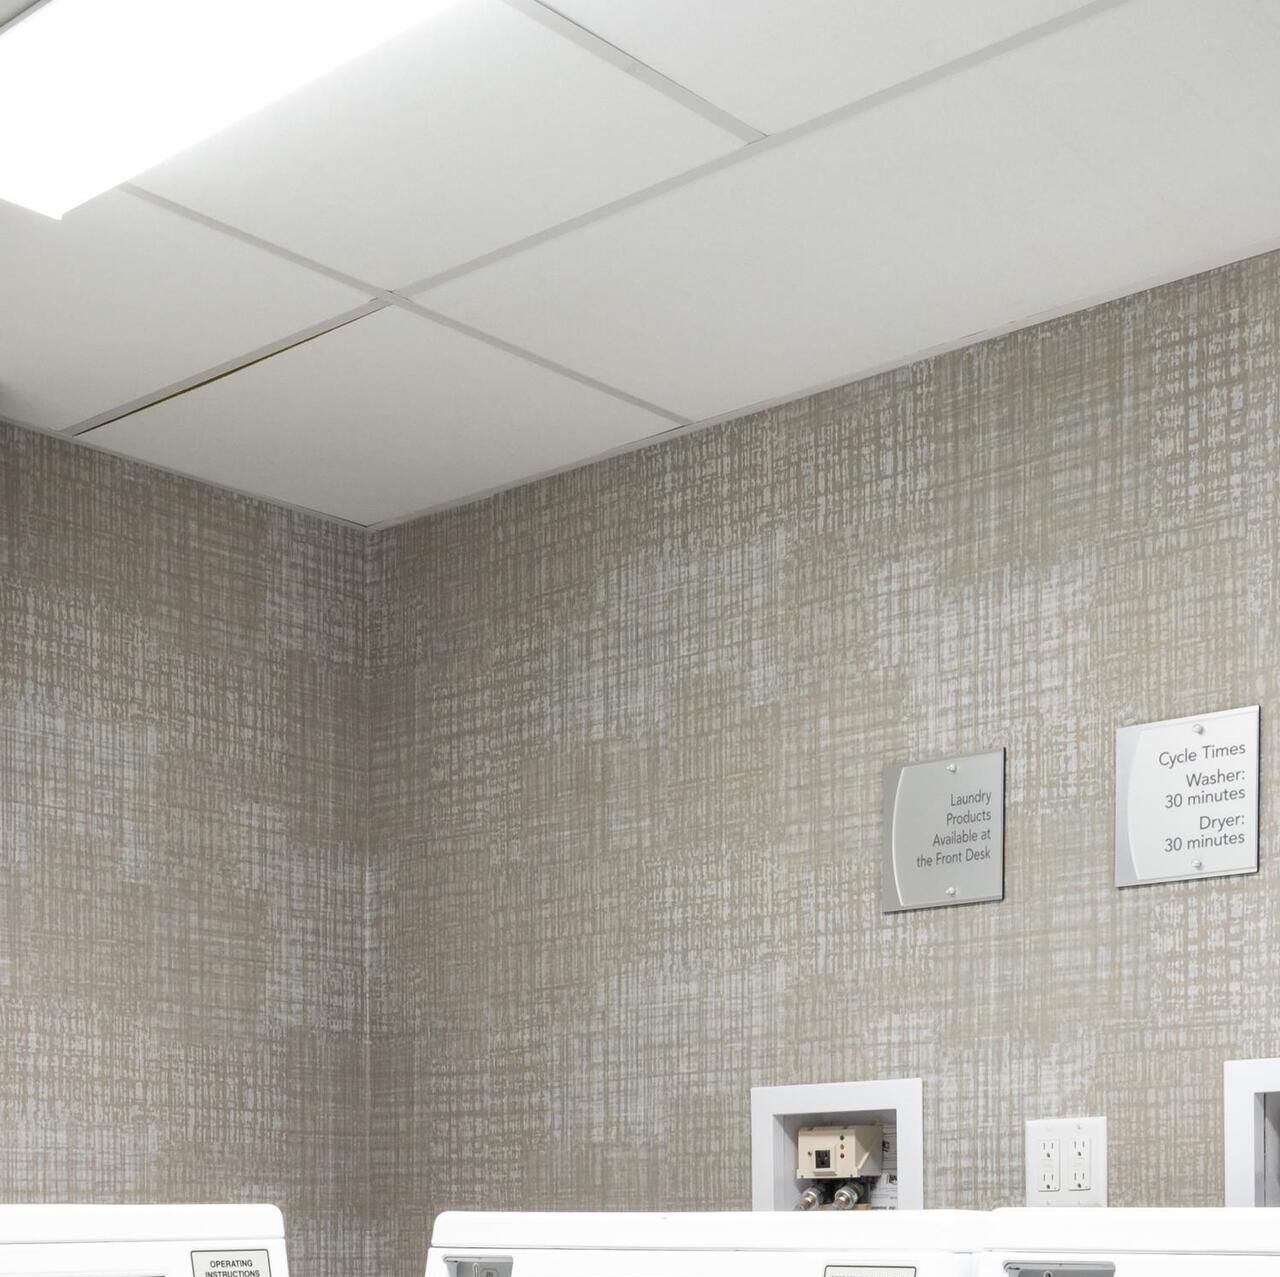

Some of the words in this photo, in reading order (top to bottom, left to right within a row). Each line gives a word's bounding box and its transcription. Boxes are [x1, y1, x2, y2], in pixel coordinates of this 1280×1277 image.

[1158, 747, 1197, 770] Cycle
[1202, 743, 1246, 760] Times
[1186, 768, 1245, 788] Washer:
[950, 788, 992, 807] Laundry
[1165, 793, 1183, 809] 30
[1187, 788, 1246, 806] minutes
[946, 809, 992, 826] Products
[1199, 815, 1245, 832] Dryer:
[932, 828, 978, 847] Available
[981, 829, 991, 841] at
[1164, 836, 1183, 853] 30
[1187, 833, 1245, 850] minutes
[917, 853, 933, 868] the
[935, 851, 962, 865] Front
[965, 845, 991, 862] Desk
[209, 1259, 253, 1269] OPERATING
